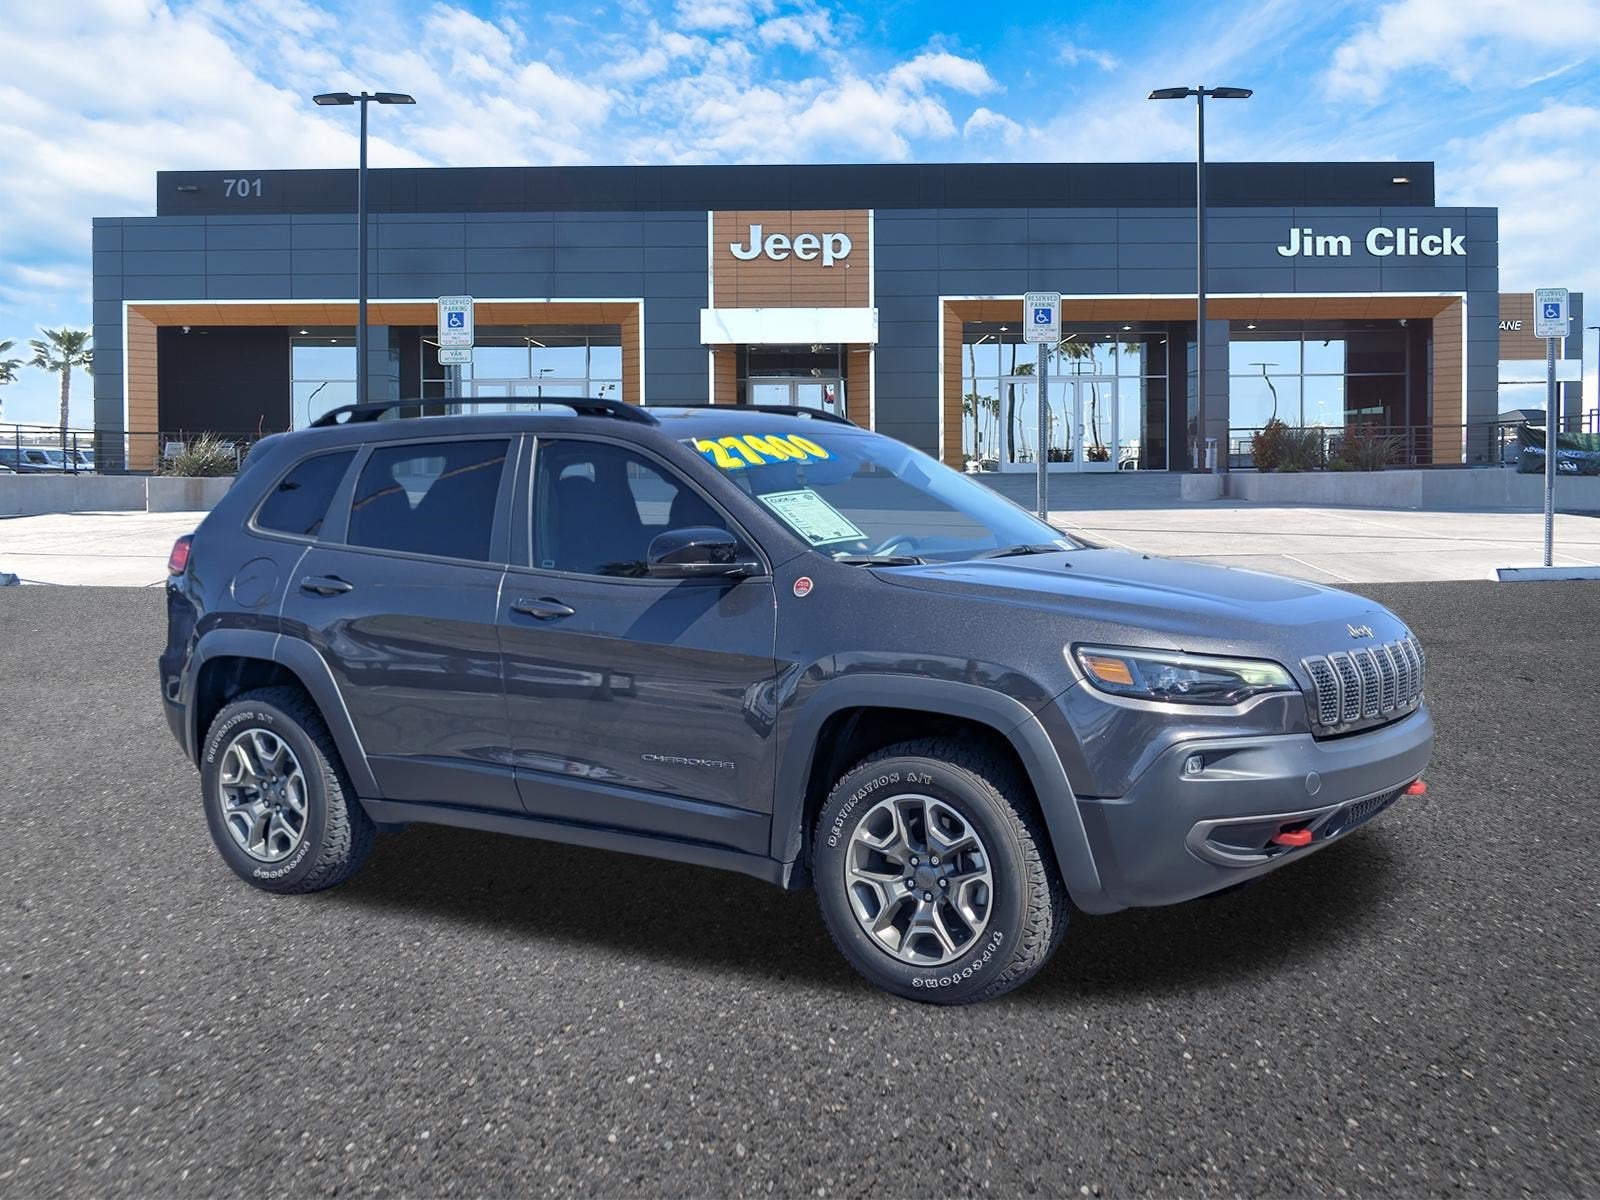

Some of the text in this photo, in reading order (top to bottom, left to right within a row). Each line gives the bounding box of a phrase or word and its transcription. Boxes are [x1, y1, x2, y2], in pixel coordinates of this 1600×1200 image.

[224, 178, 262, 197] 701
[730, 224, 852, 267] Jeep
[1277, 227, 1467, 257] Jim Click
[696, 434, 829, 468] 27900
[1346, 623, 1374, 639] Jeep
[207, 711, 254, 763] DESTINATION
[641, 753, 735, 769] CHEROKEE
[827, 772, 933, 847] DESTINATION A/T
